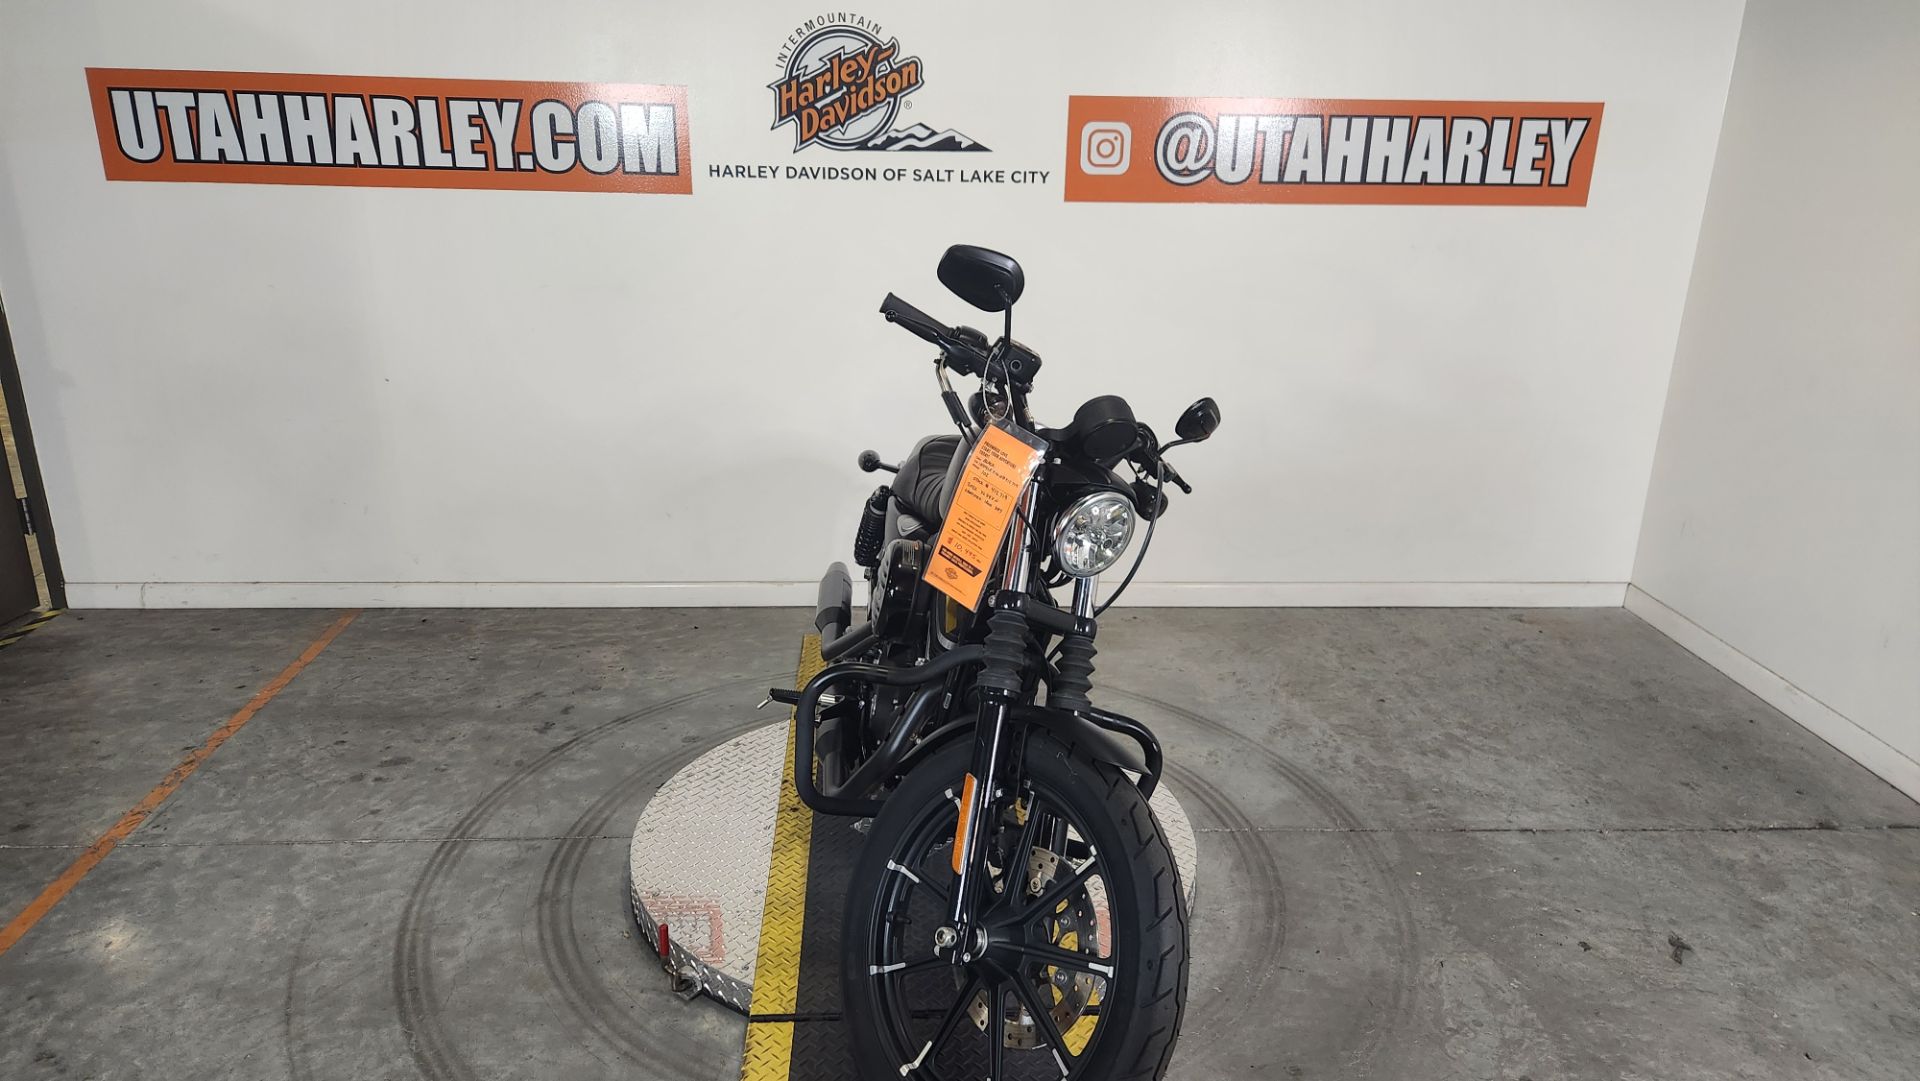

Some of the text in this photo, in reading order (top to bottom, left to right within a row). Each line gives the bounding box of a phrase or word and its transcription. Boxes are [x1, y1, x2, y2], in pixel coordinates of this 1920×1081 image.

[775, 12, 883, 69] INTERMOUNTAIN
[107, 86, 679, 176] UTAHHARLEY.COM
[801, 59, 918, 142] Davidson
[709, 164, 1050, 184] HARLEY DAVIDSON OF SALT LAKE CITY
[1154, 111, 1592, 188] @UTAHHARLEY
